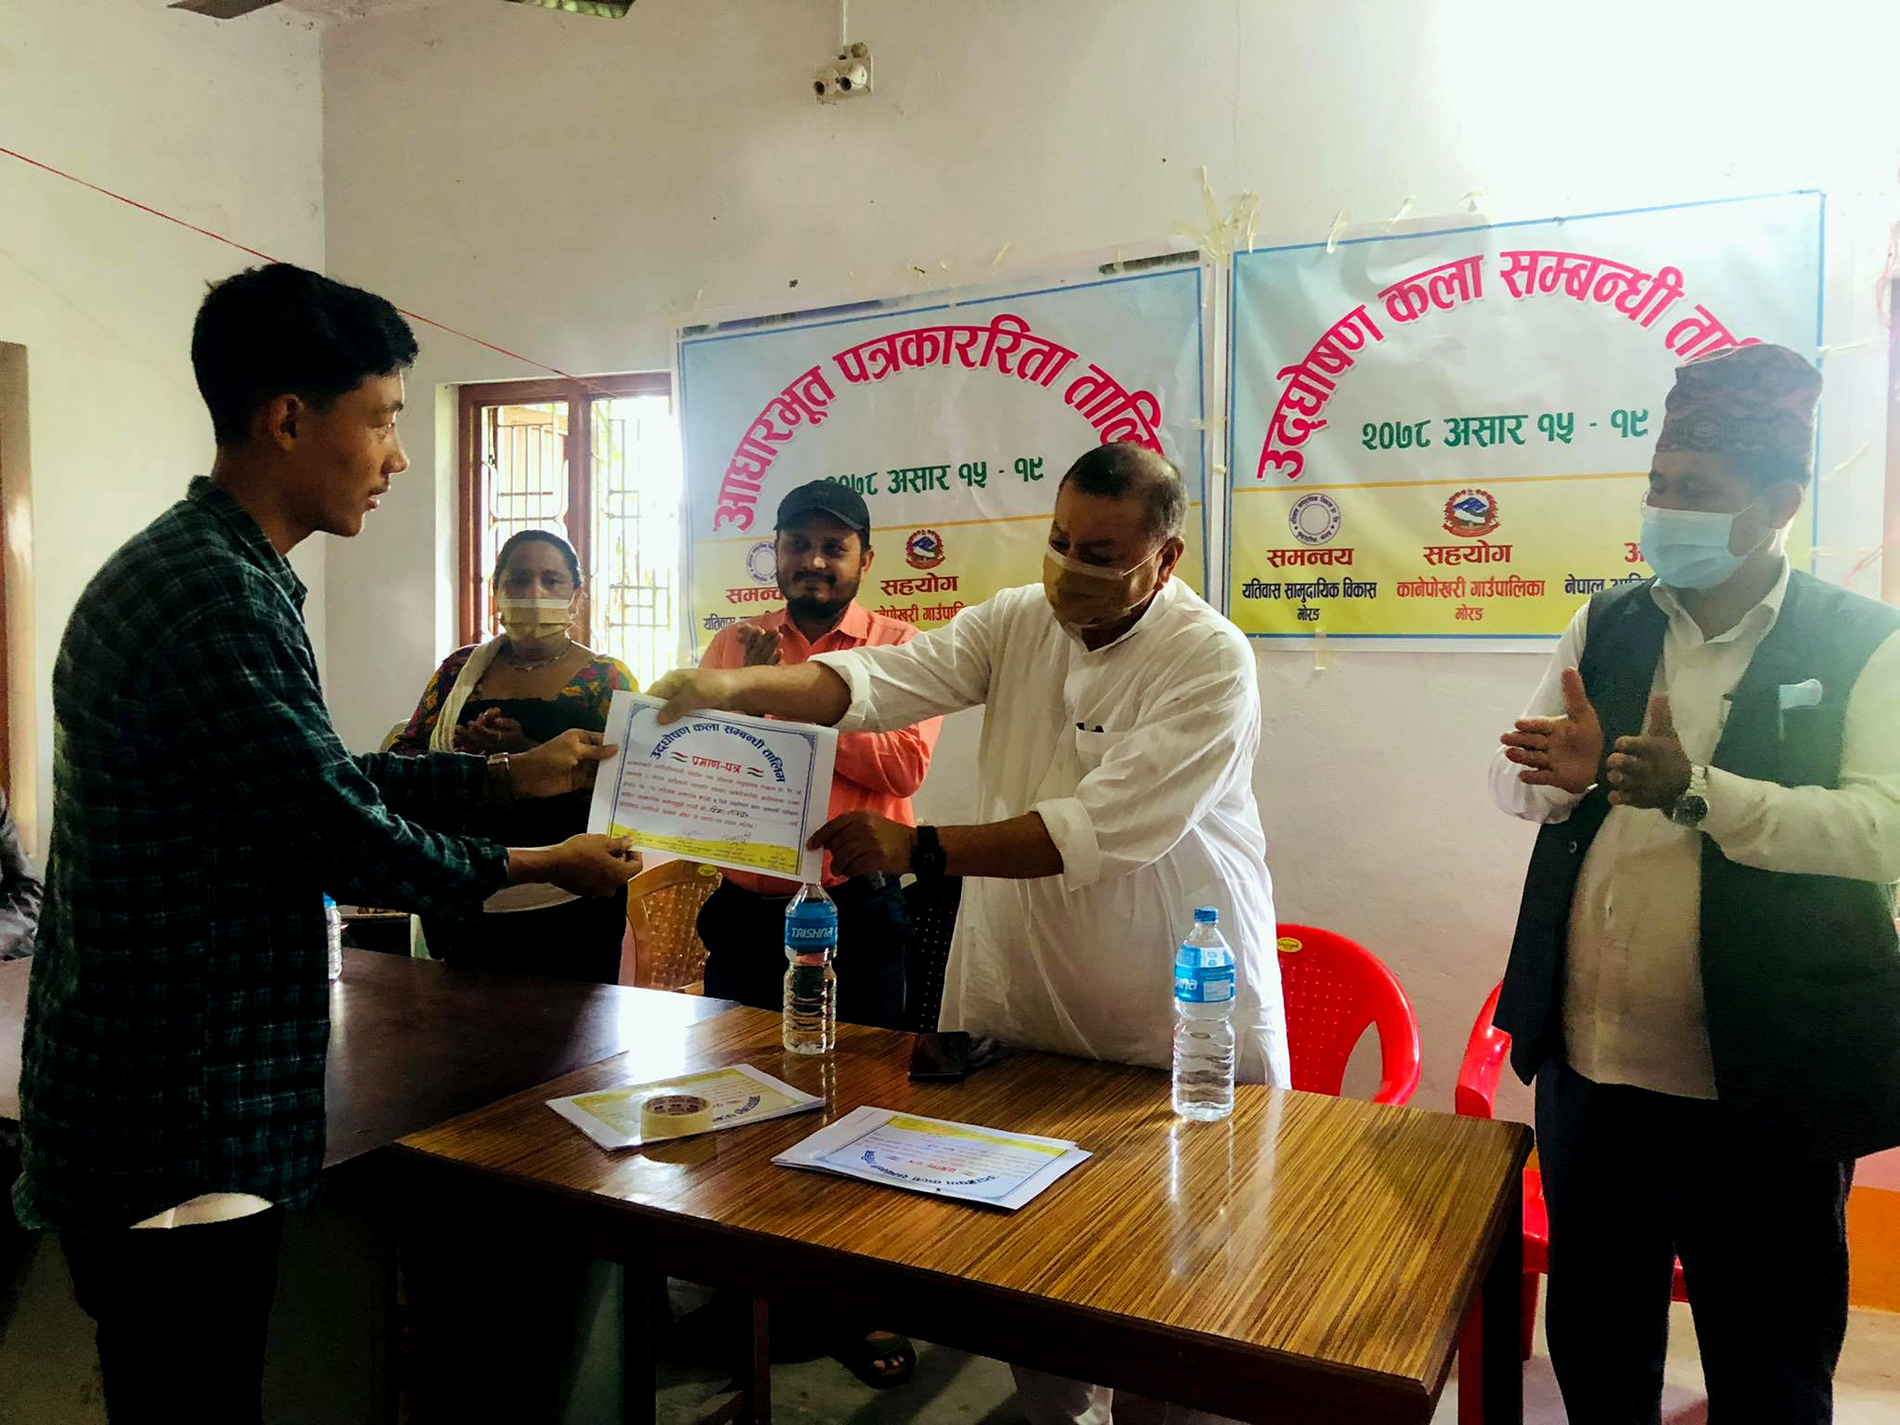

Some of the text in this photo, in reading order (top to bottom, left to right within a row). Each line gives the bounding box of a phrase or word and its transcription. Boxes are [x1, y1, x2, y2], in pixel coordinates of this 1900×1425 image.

[1377, 254, 1484, 322] कला
[1500, 250, 1686, 328] सम्बन्धी
[1362, 419, 1431, 450] २०७८
[1443, 414, 1529, 448] असार
[1538, 412, 1574, 444] १५
[1610, 409, 1648, 438] १९
[713, 365, 836, 532] आधारभूत
[1064, 363, 1165, 459] तालि
[887, 464, 951, 494] असार
[958, 461, 987, 488] १५
[1014, 456, 1044, 482] १९
[1267, 547, 1355, 568] समन्वय
[1423, 539, 1513, 566] सहयोग
[726, 586, 784, 604] समन्व
[880, 572, 959, 596] सहयोग
[1343, 576, 1378, 599] विकास
[693, 722, 720, 732] कला
